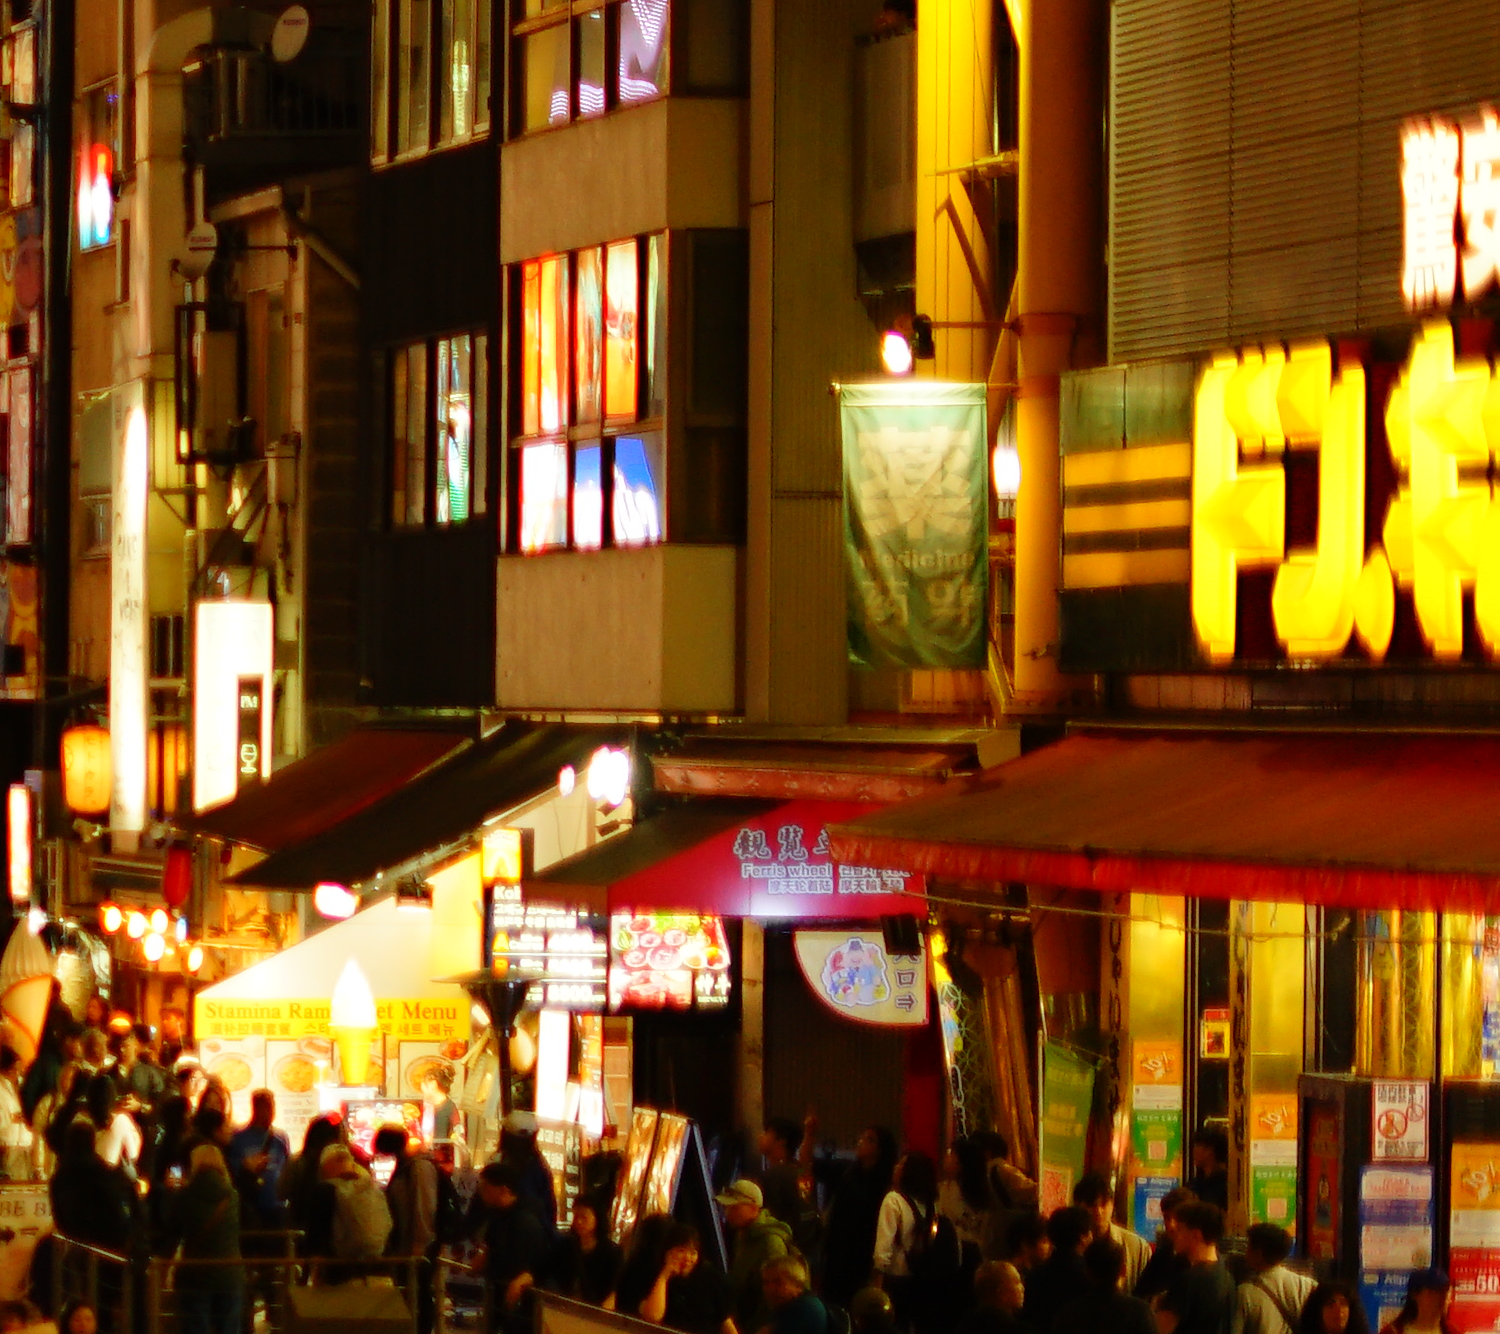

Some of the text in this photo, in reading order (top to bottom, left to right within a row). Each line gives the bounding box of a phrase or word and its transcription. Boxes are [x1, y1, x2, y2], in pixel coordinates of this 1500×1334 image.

[858, 423, 972, 540] 薬
[742, 863, 833, 878] Ferris wheel
[205, 1001, 281, 1020] Stamina
[401, 1001, 457, 1020] Menu
